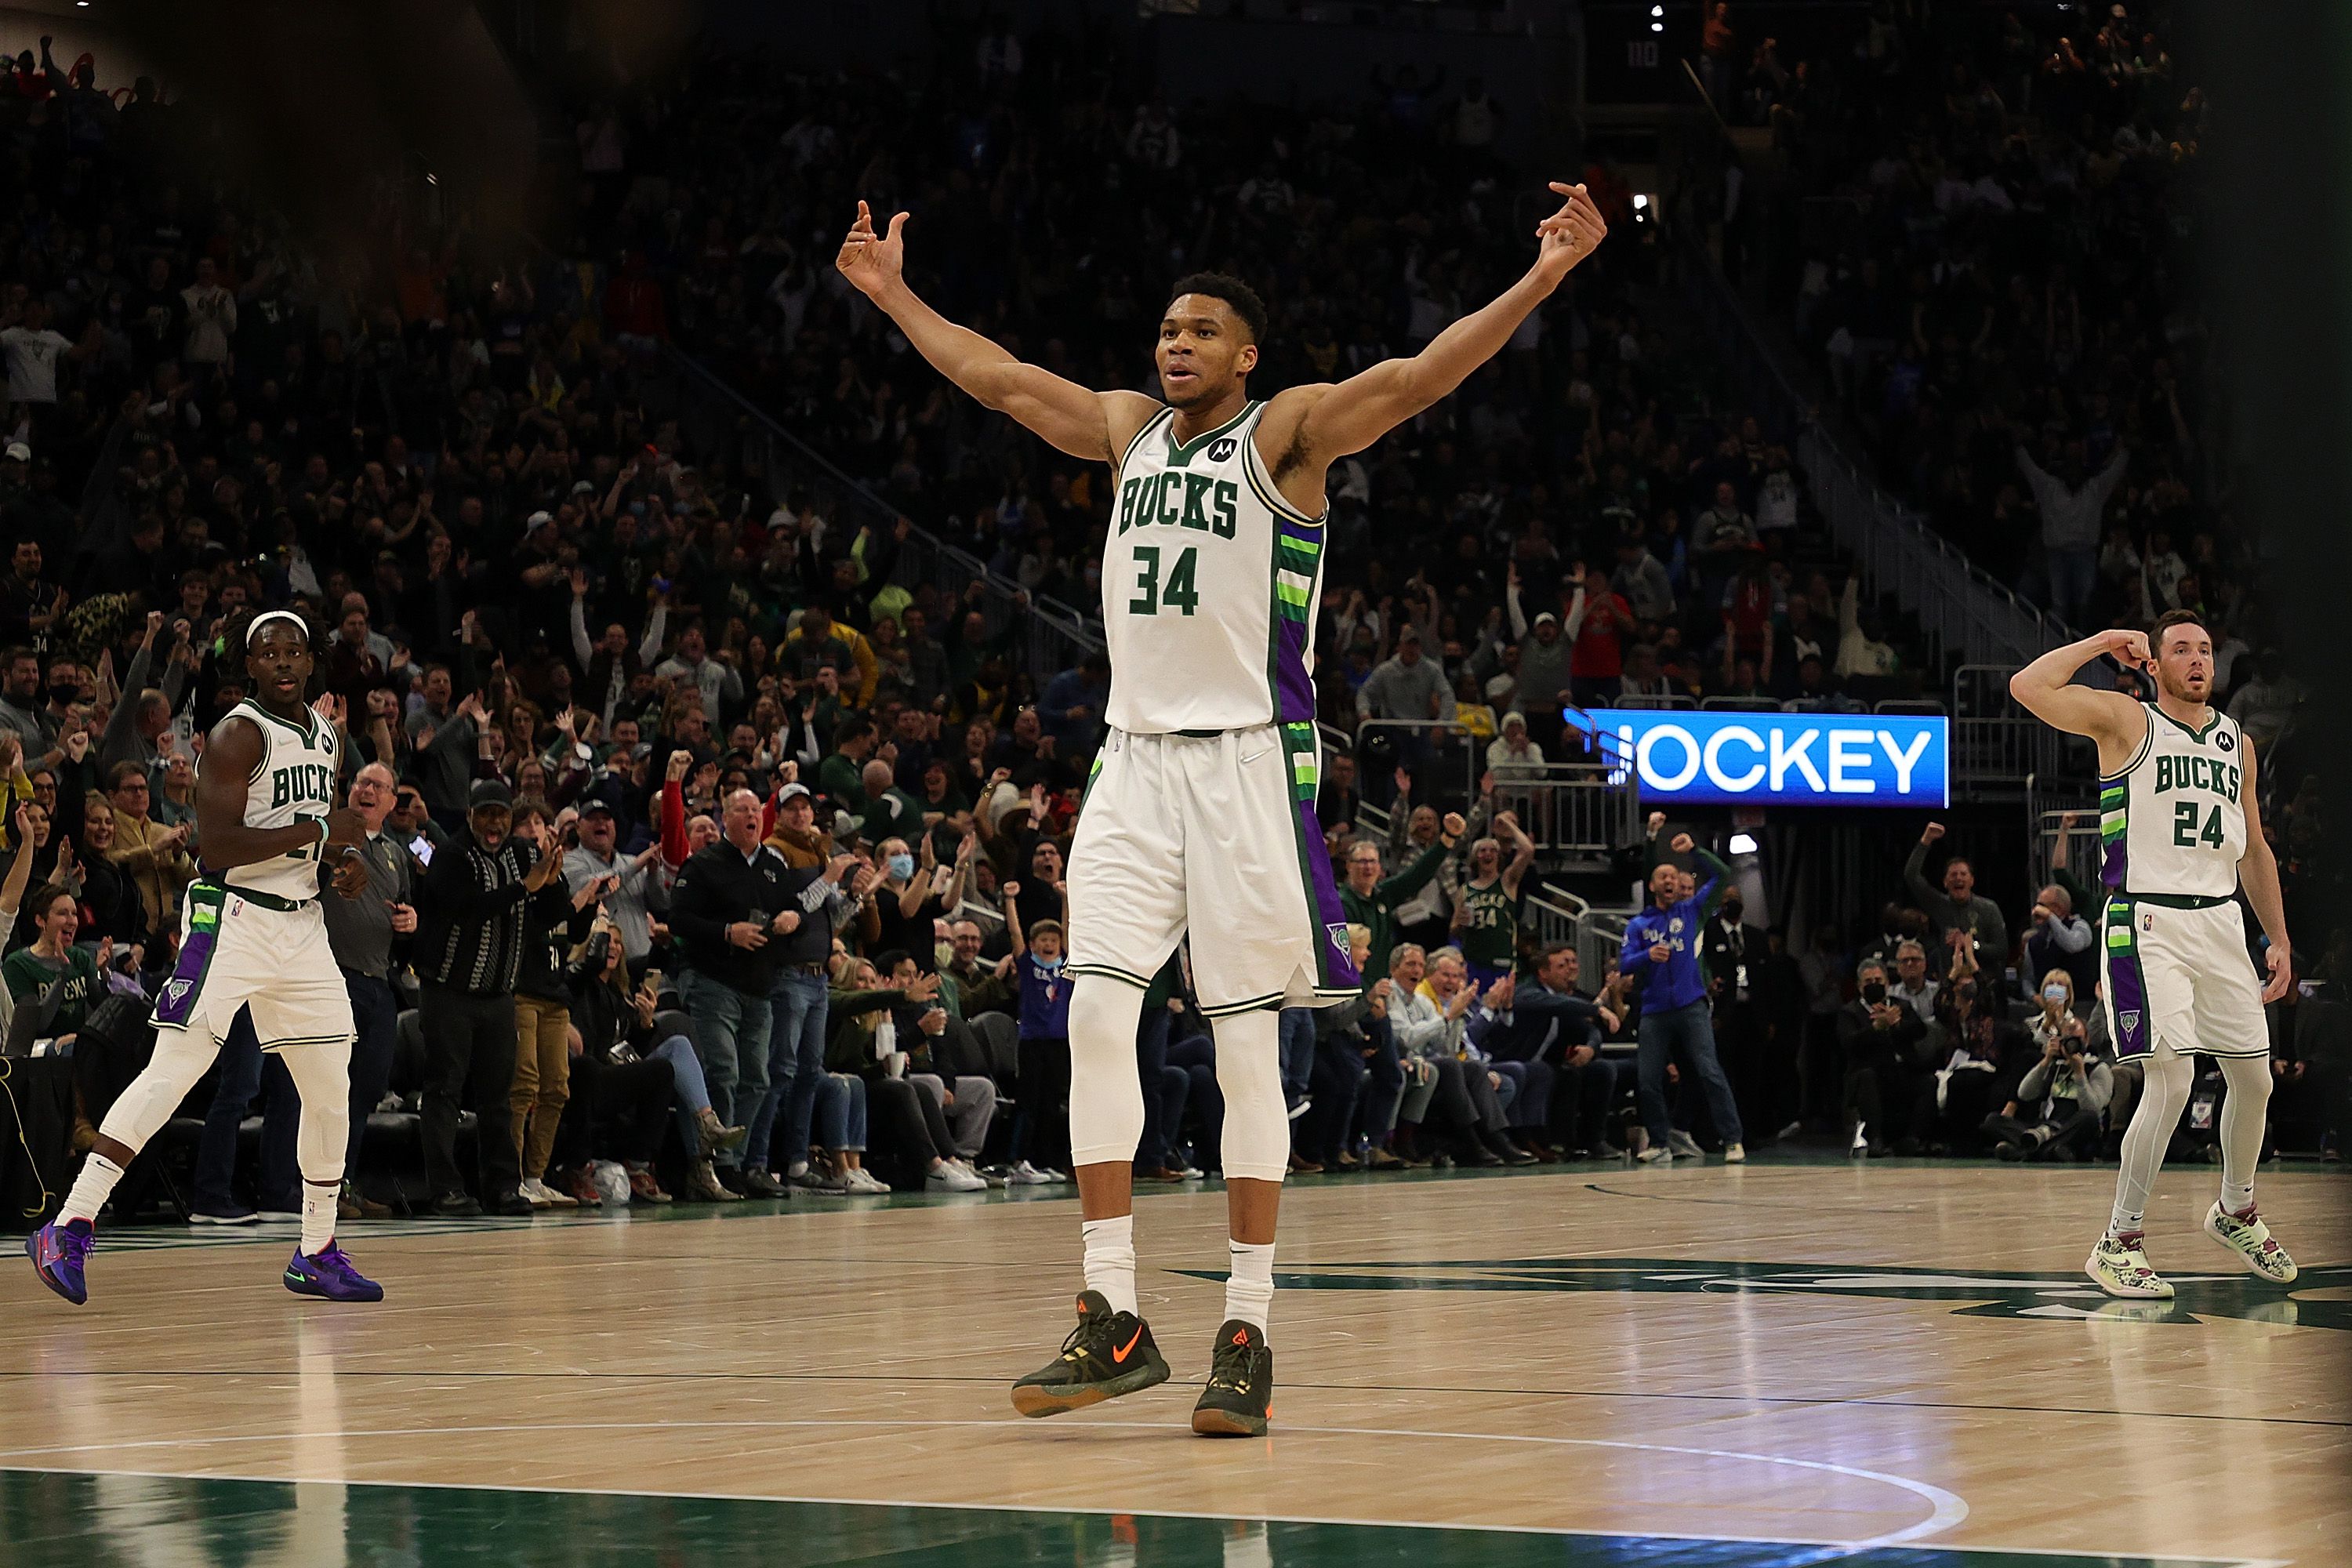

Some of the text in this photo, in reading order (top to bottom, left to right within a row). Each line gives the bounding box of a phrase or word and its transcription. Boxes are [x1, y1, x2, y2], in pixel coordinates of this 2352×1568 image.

[1118, 471, 1238, 540] BUCKS
[1128, 546, 1199, 616] 34
[2154, 755, 2240, 804] BUCKS
[2173, 801, 2224, 850] 24
[1475, 908, 1498, 929] 34
[38, 975, 88, 1005] BCK
